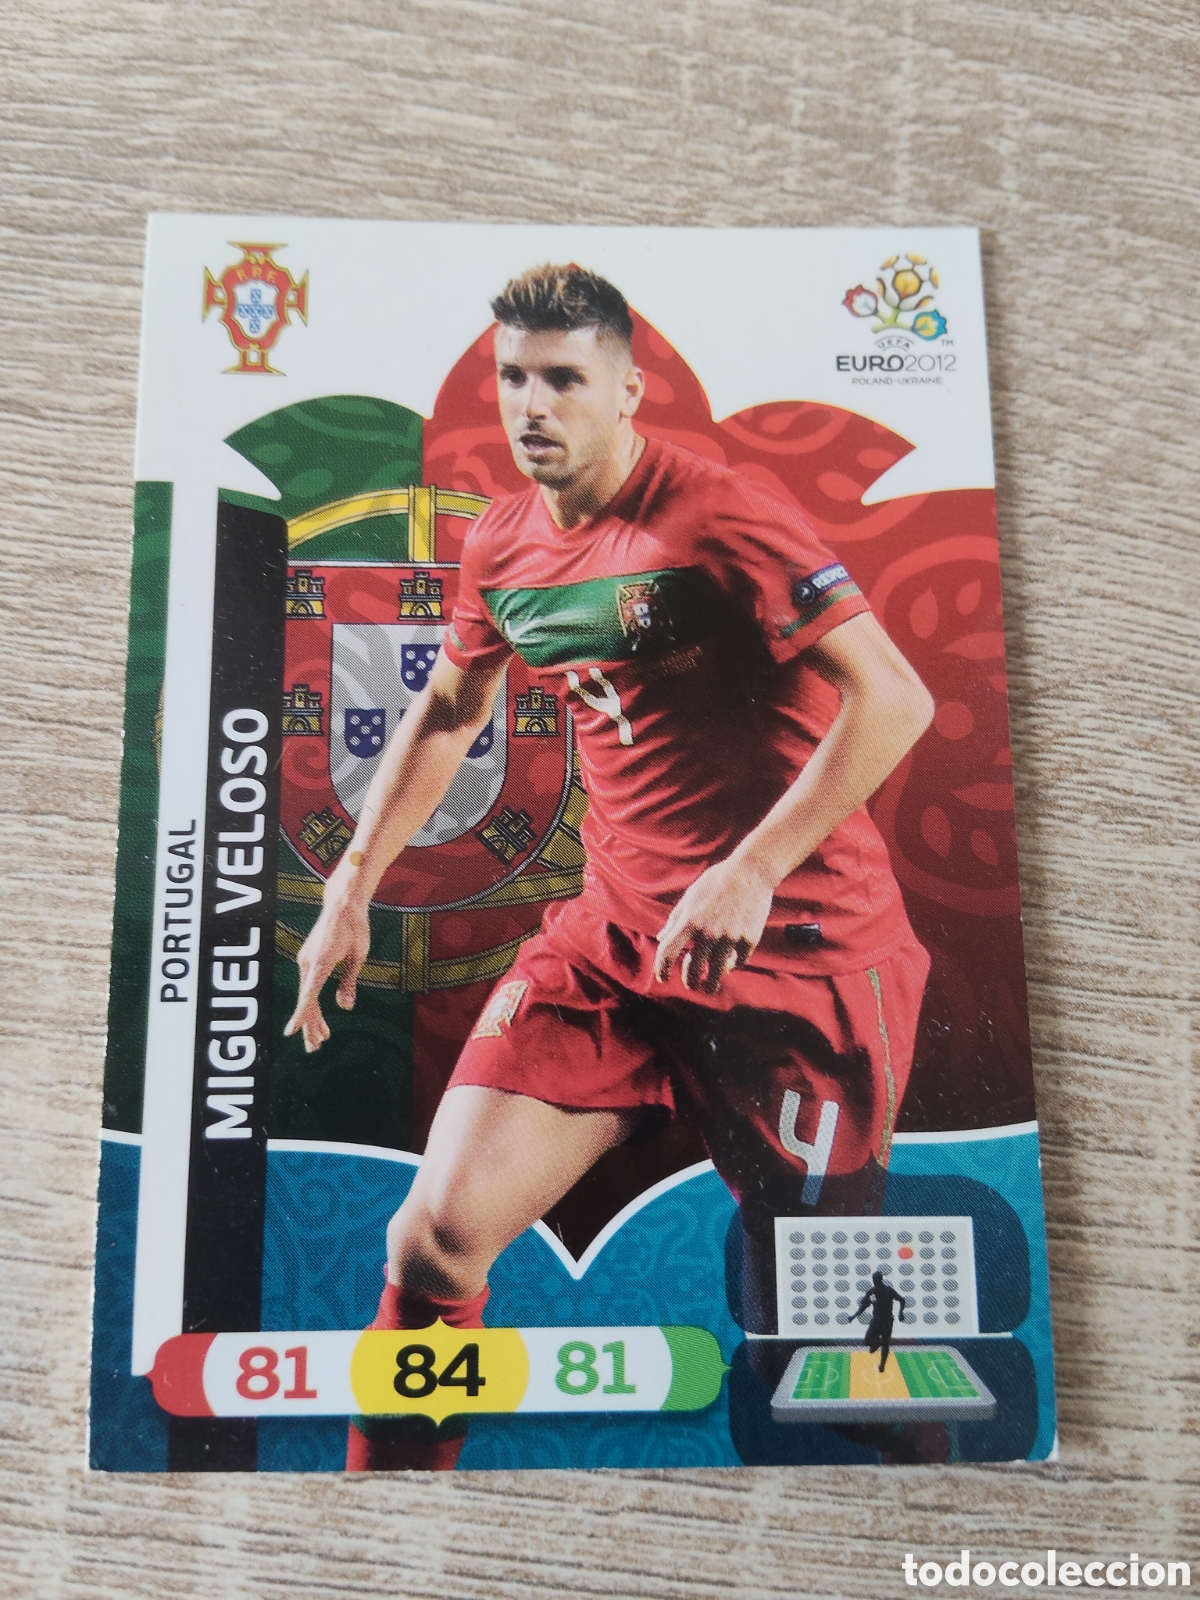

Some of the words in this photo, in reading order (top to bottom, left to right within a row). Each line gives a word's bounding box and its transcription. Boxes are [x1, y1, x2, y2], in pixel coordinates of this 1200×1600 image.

[852, 377, 943, 386] POLAND-UKRAINE
[877, 339, 911, 350] UEFA
[215, 707, 270, 915] VELOSO
[160, 818, 198, 1003] PORTUGAL
[204, 926, 262, 1140] MIGUEL
[779, 1088, 840, 1207] 4
[235, 1346, 318, 1400] 81
[393, 1343, 486, 1398] 84
[554, 1340, 637, 1396] 81
